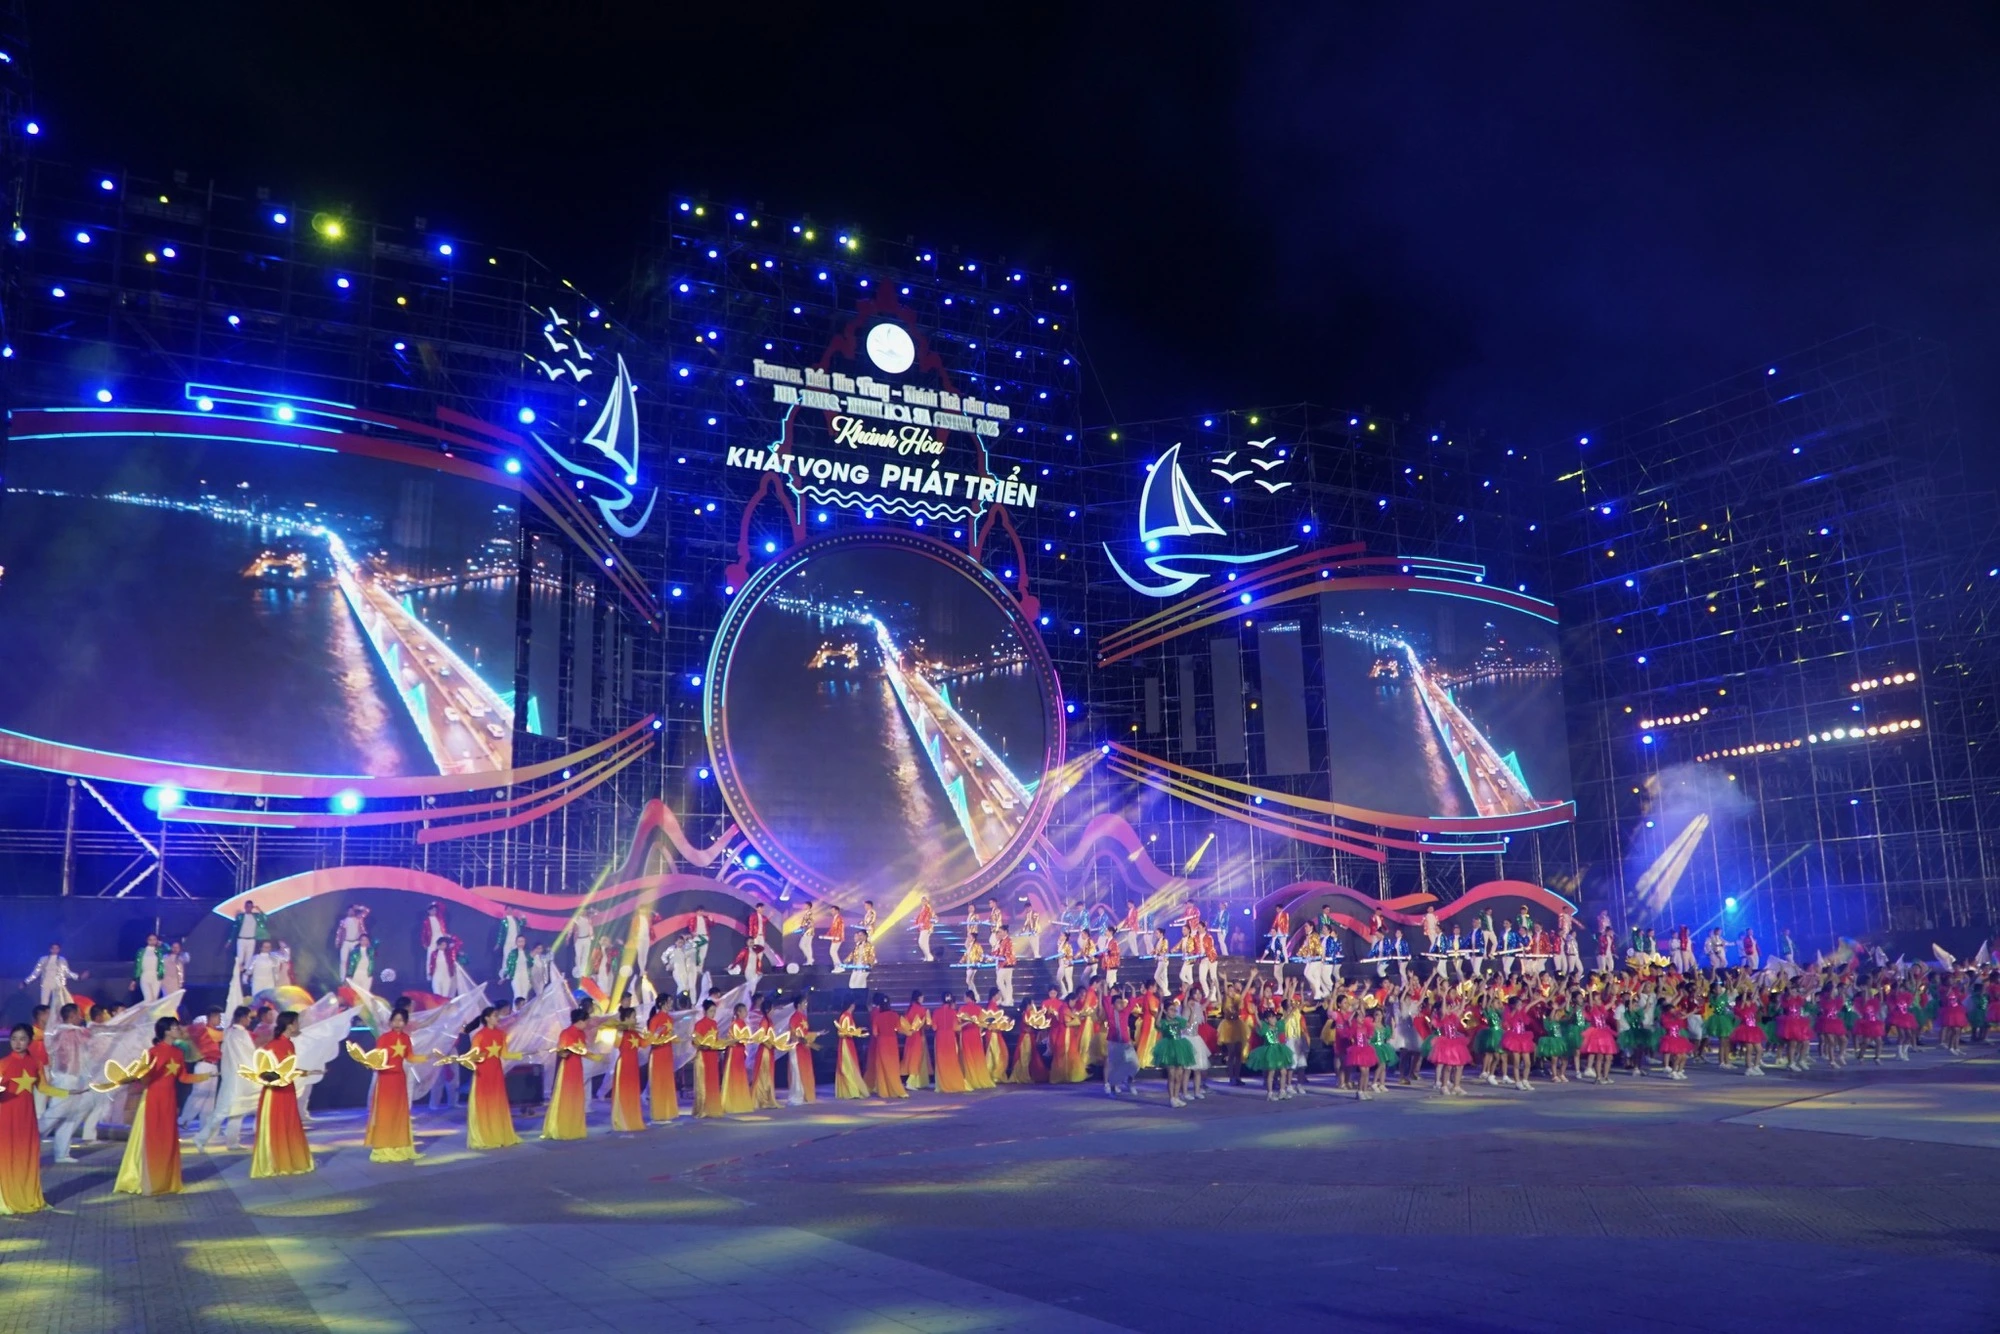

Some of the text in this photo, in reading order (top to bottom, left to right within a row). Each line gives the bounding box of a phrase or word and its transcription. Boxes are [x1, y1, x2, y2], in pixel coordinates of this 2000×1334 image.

[856, 377, 890, 402] Trang
[832, 415, 944, 457] Khánh Hòa
[726, 445, 1038, 508] KHÁT VỌNG PHÁT TRIỂN
